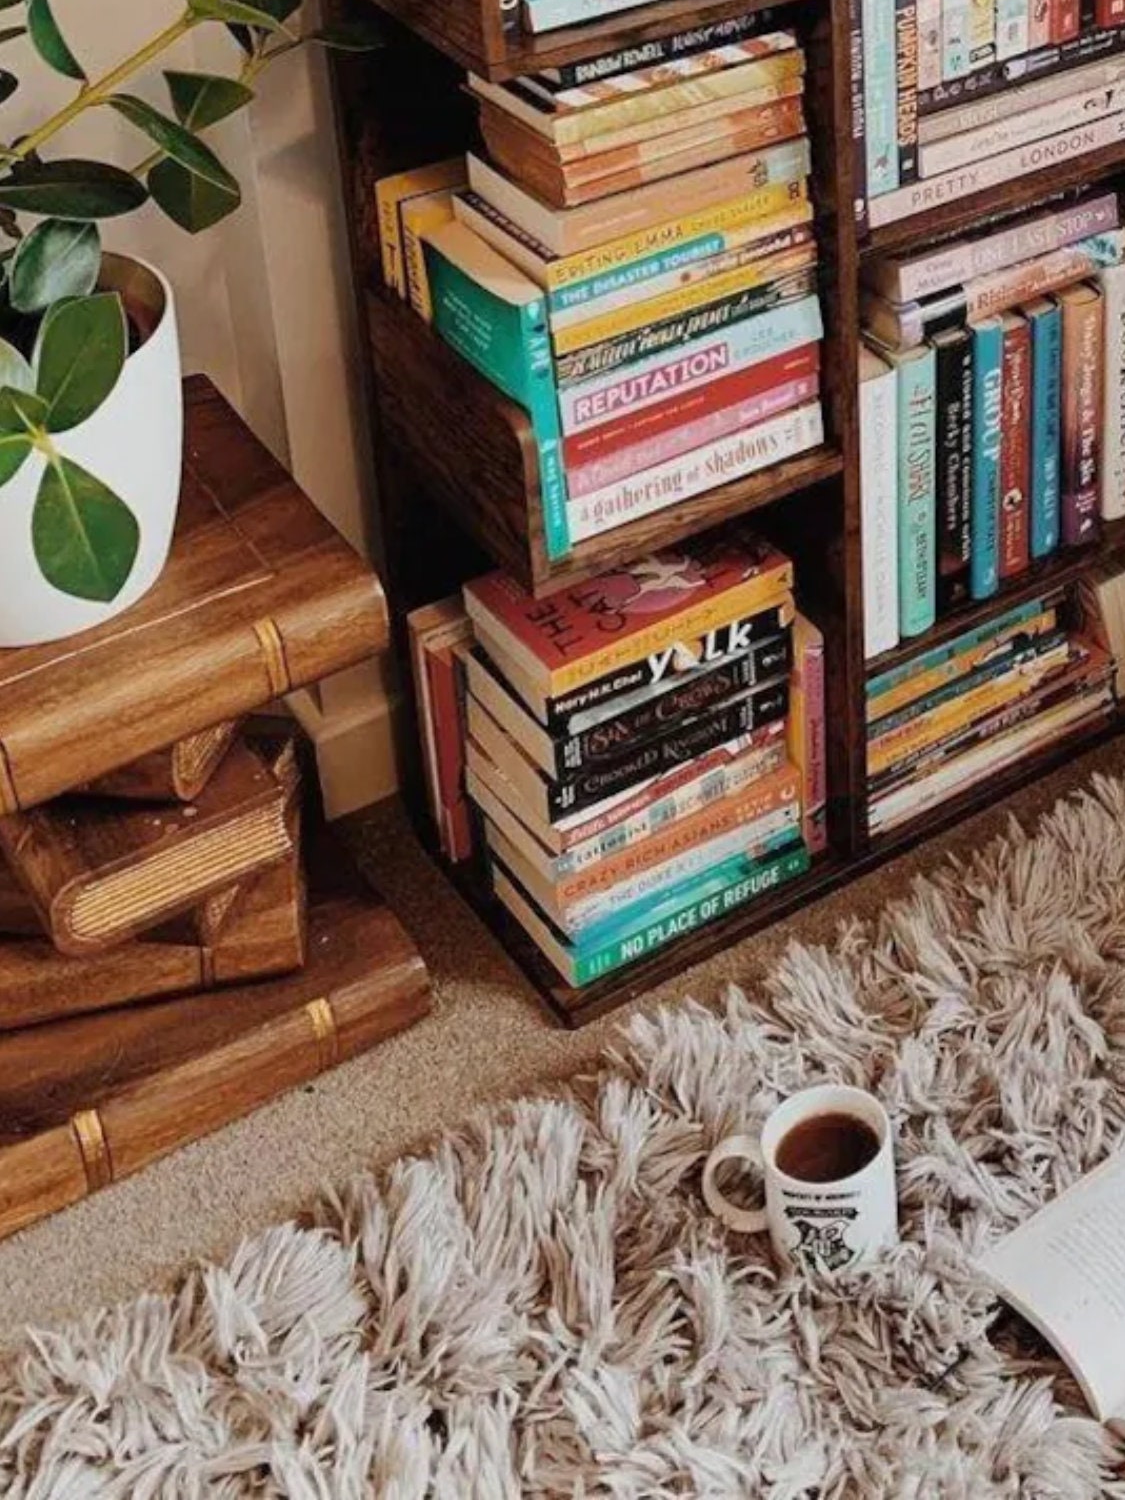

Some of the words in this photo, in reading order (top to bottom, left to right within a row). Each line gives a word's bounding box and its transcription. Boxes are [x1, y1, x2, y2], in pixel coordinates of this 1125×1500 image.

[911, 171, 980, 206] PRETTY
[1019, 131, 1096, 169] LONDON
[556, 246, 627, 283] EDITING
[634, 225, 683, 252] EMMA
[561, 287, 590, 305] THE
[592, 263, 660, 295] DISASTER
[575, 344, 729, 423] REPUTATION
[1079, 427, 1094, 457] The
[593, 472, 684, 524] gathering
[704, 434, 778, 477] shadows
[563, 867, 618, 898] CRAZY
[624, 843, 666, 871] RICH
[619, 935, 645, 961] NO
[648, 911, 698, 949] PLACE
[700, 897, 720, 918] OF
[723, 866, 780, 908] REFUGE
